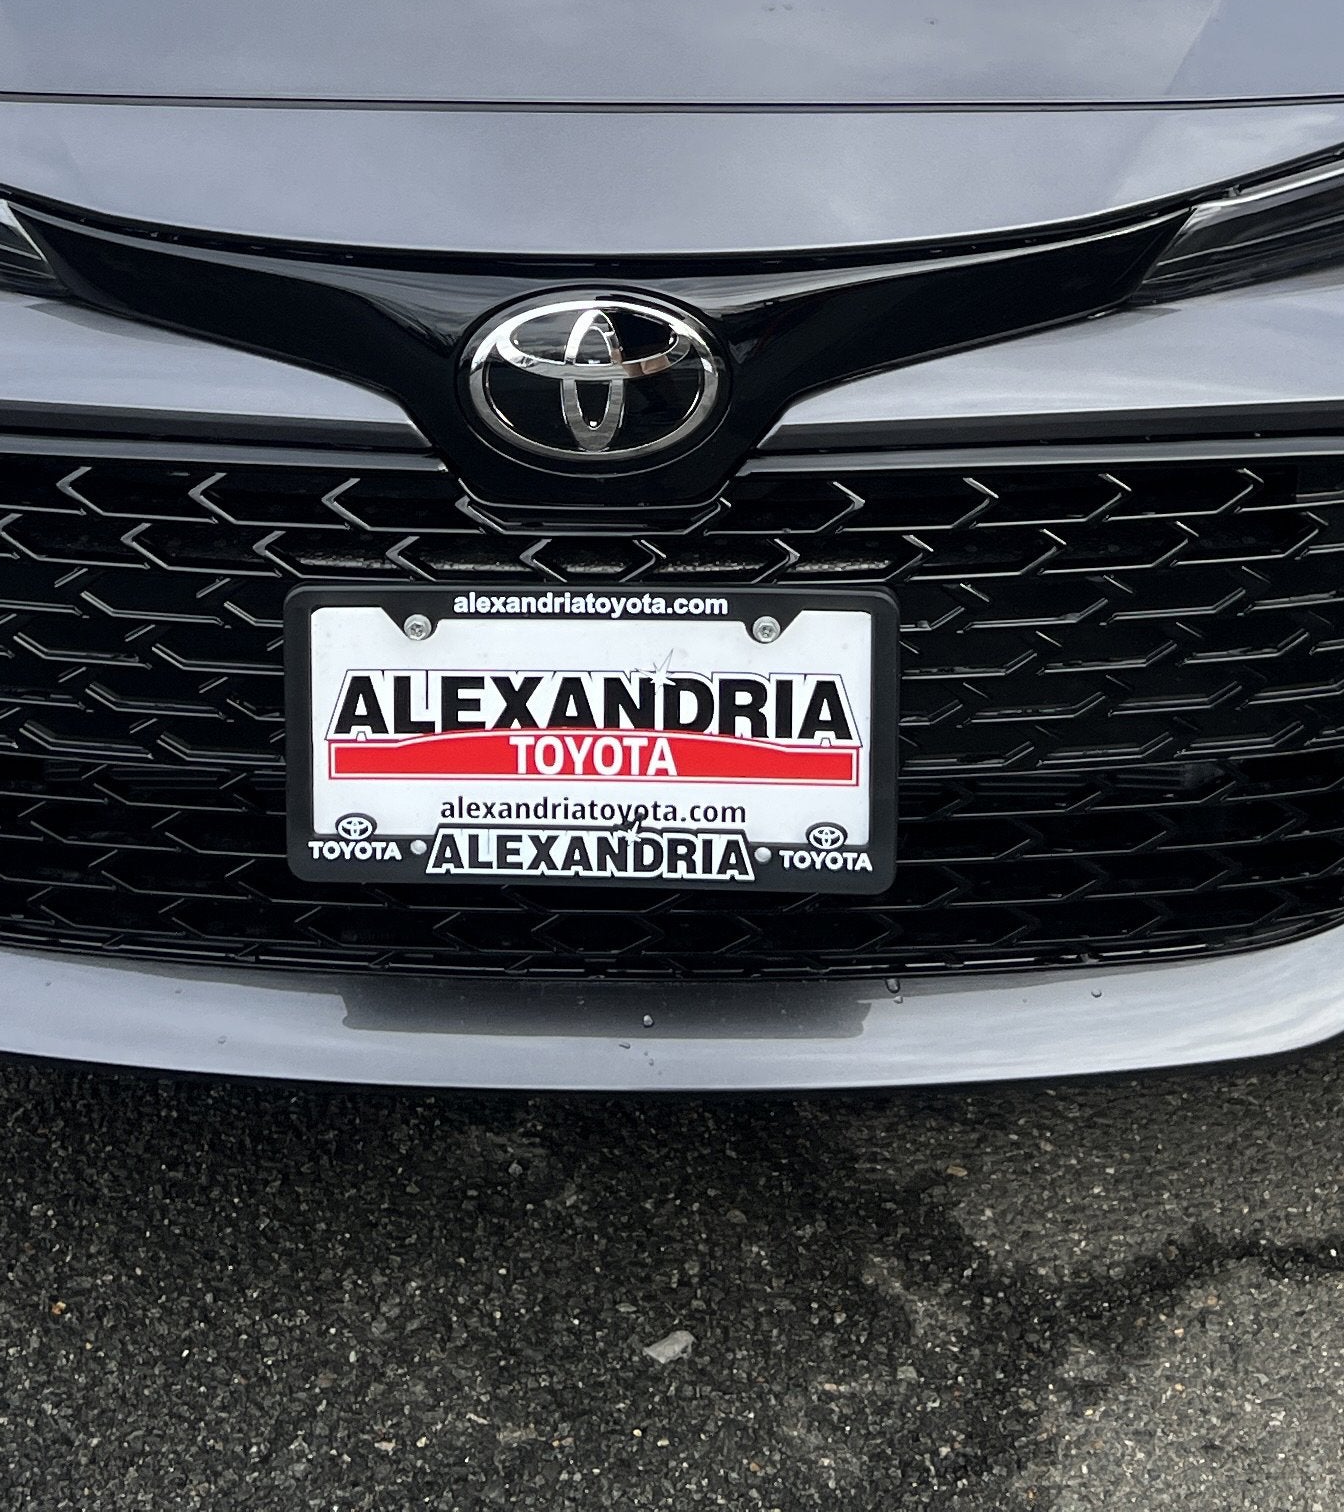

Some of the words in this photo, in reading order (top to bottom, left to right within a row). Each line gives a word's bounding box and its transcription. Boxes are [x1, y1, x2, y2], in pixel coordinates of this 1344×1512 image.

[453, 593, 728, 619] alexandriatoyota.com
[329, 671, 859, 744] ALEXANDRIA
[508, 735, 678, 776] TOYOTA
[440, 796, 747, 825] alexandriatoyota.com
[307, 840, 403, 861] TOYOTA
[427, 829, 754, 880] ALEXANDRIA
[779, 849, 873, 872] TOYOTA
